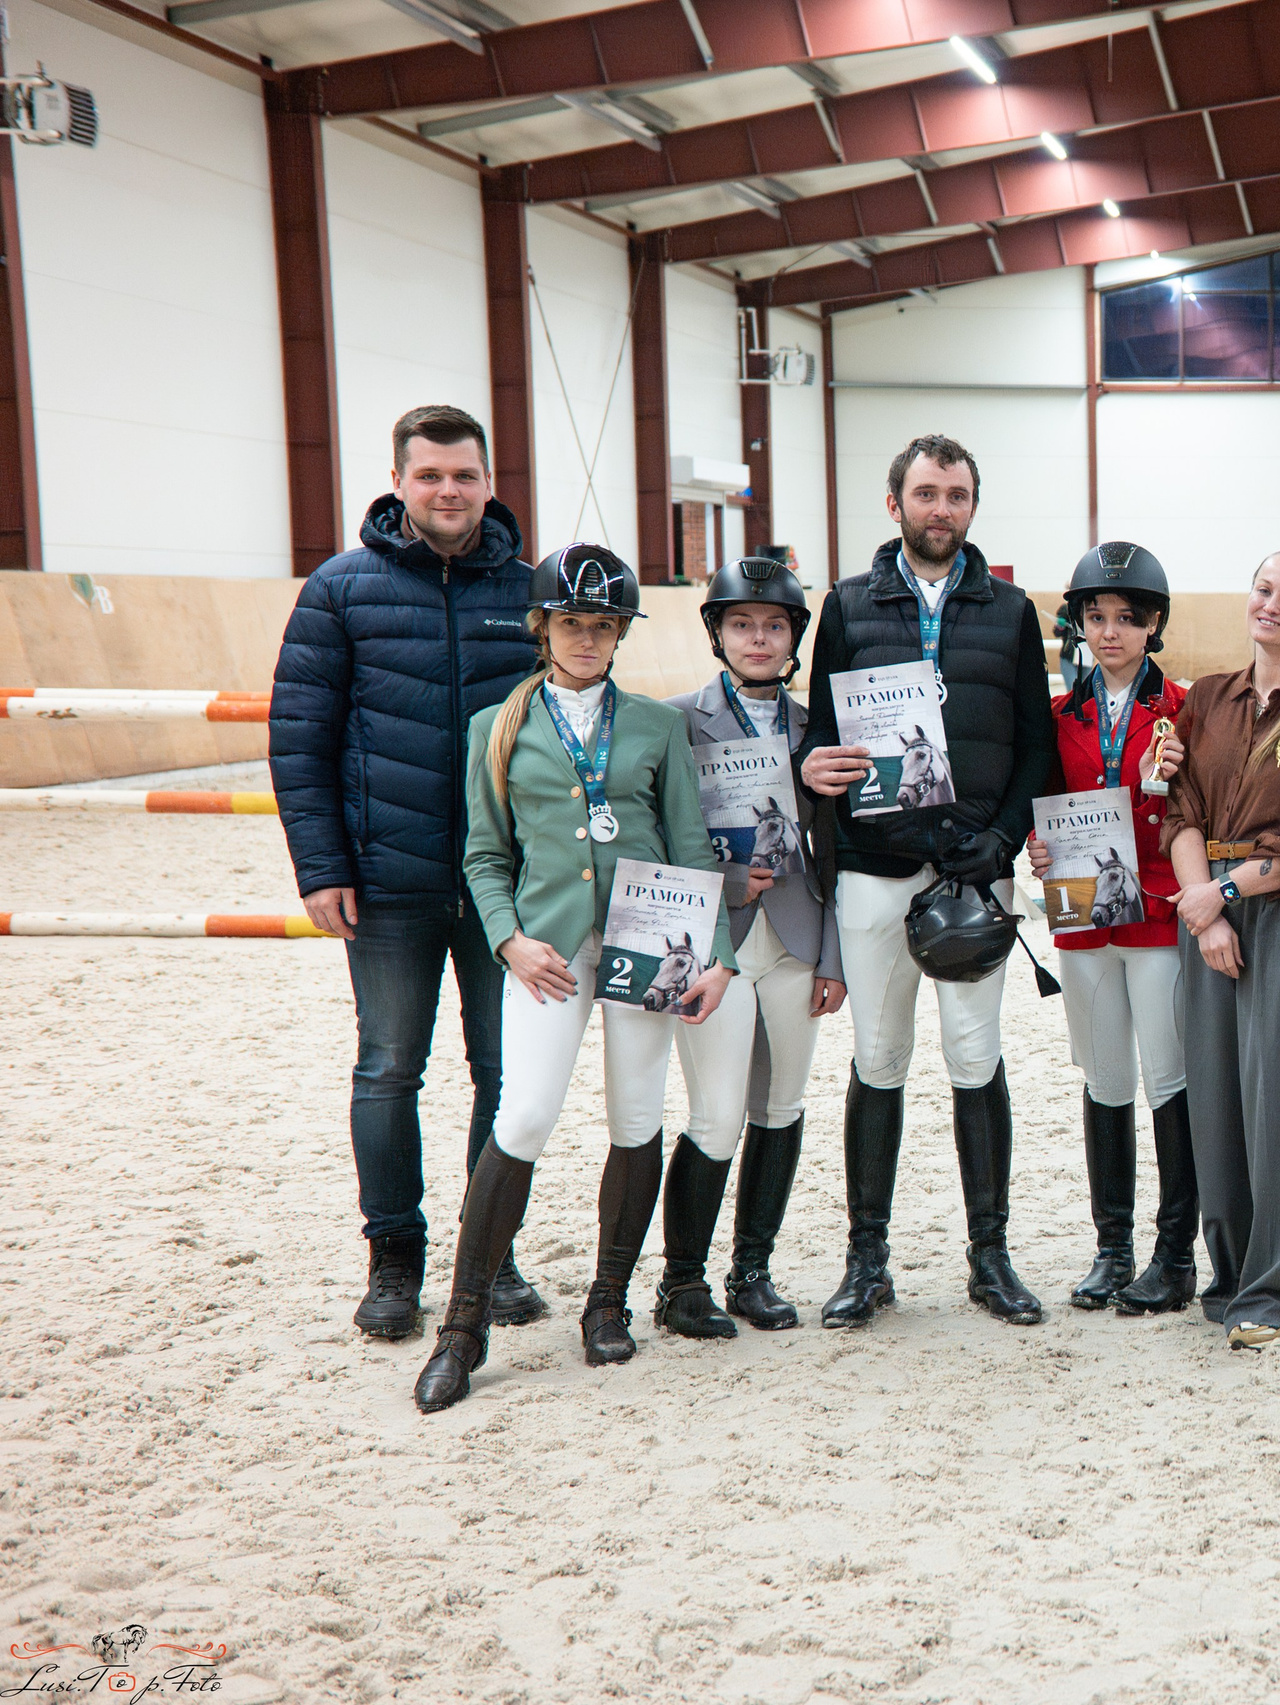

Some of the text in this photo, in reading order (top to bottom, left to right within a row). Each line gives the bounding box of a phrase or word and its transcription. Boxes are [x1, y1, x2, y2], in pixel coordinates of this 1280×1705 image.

[491, 618, 522, 627] Columbia
[923, 620, 930, 630] 2
[932, 620, 939, 630] 2
[846, 686, 926, 708] ГРАМОТА
[599, 751, 607, 760] 2
[700, 755, 779, 777] ГРАМОТА
[860, 766, 882, 795] 2
[859, 793, 885, 803] место
[1046, 810, 1121, 831] ГРАМОТА
[712, 836, 733, 863] 3
[625, 884, 706, 908] ГРАМОТА
[1056, 886, 1074, 914] 1
[1056, 913, 1079, 922] место
[608, 957, 634, 987] 2
[605, 985, 632, 995] место
